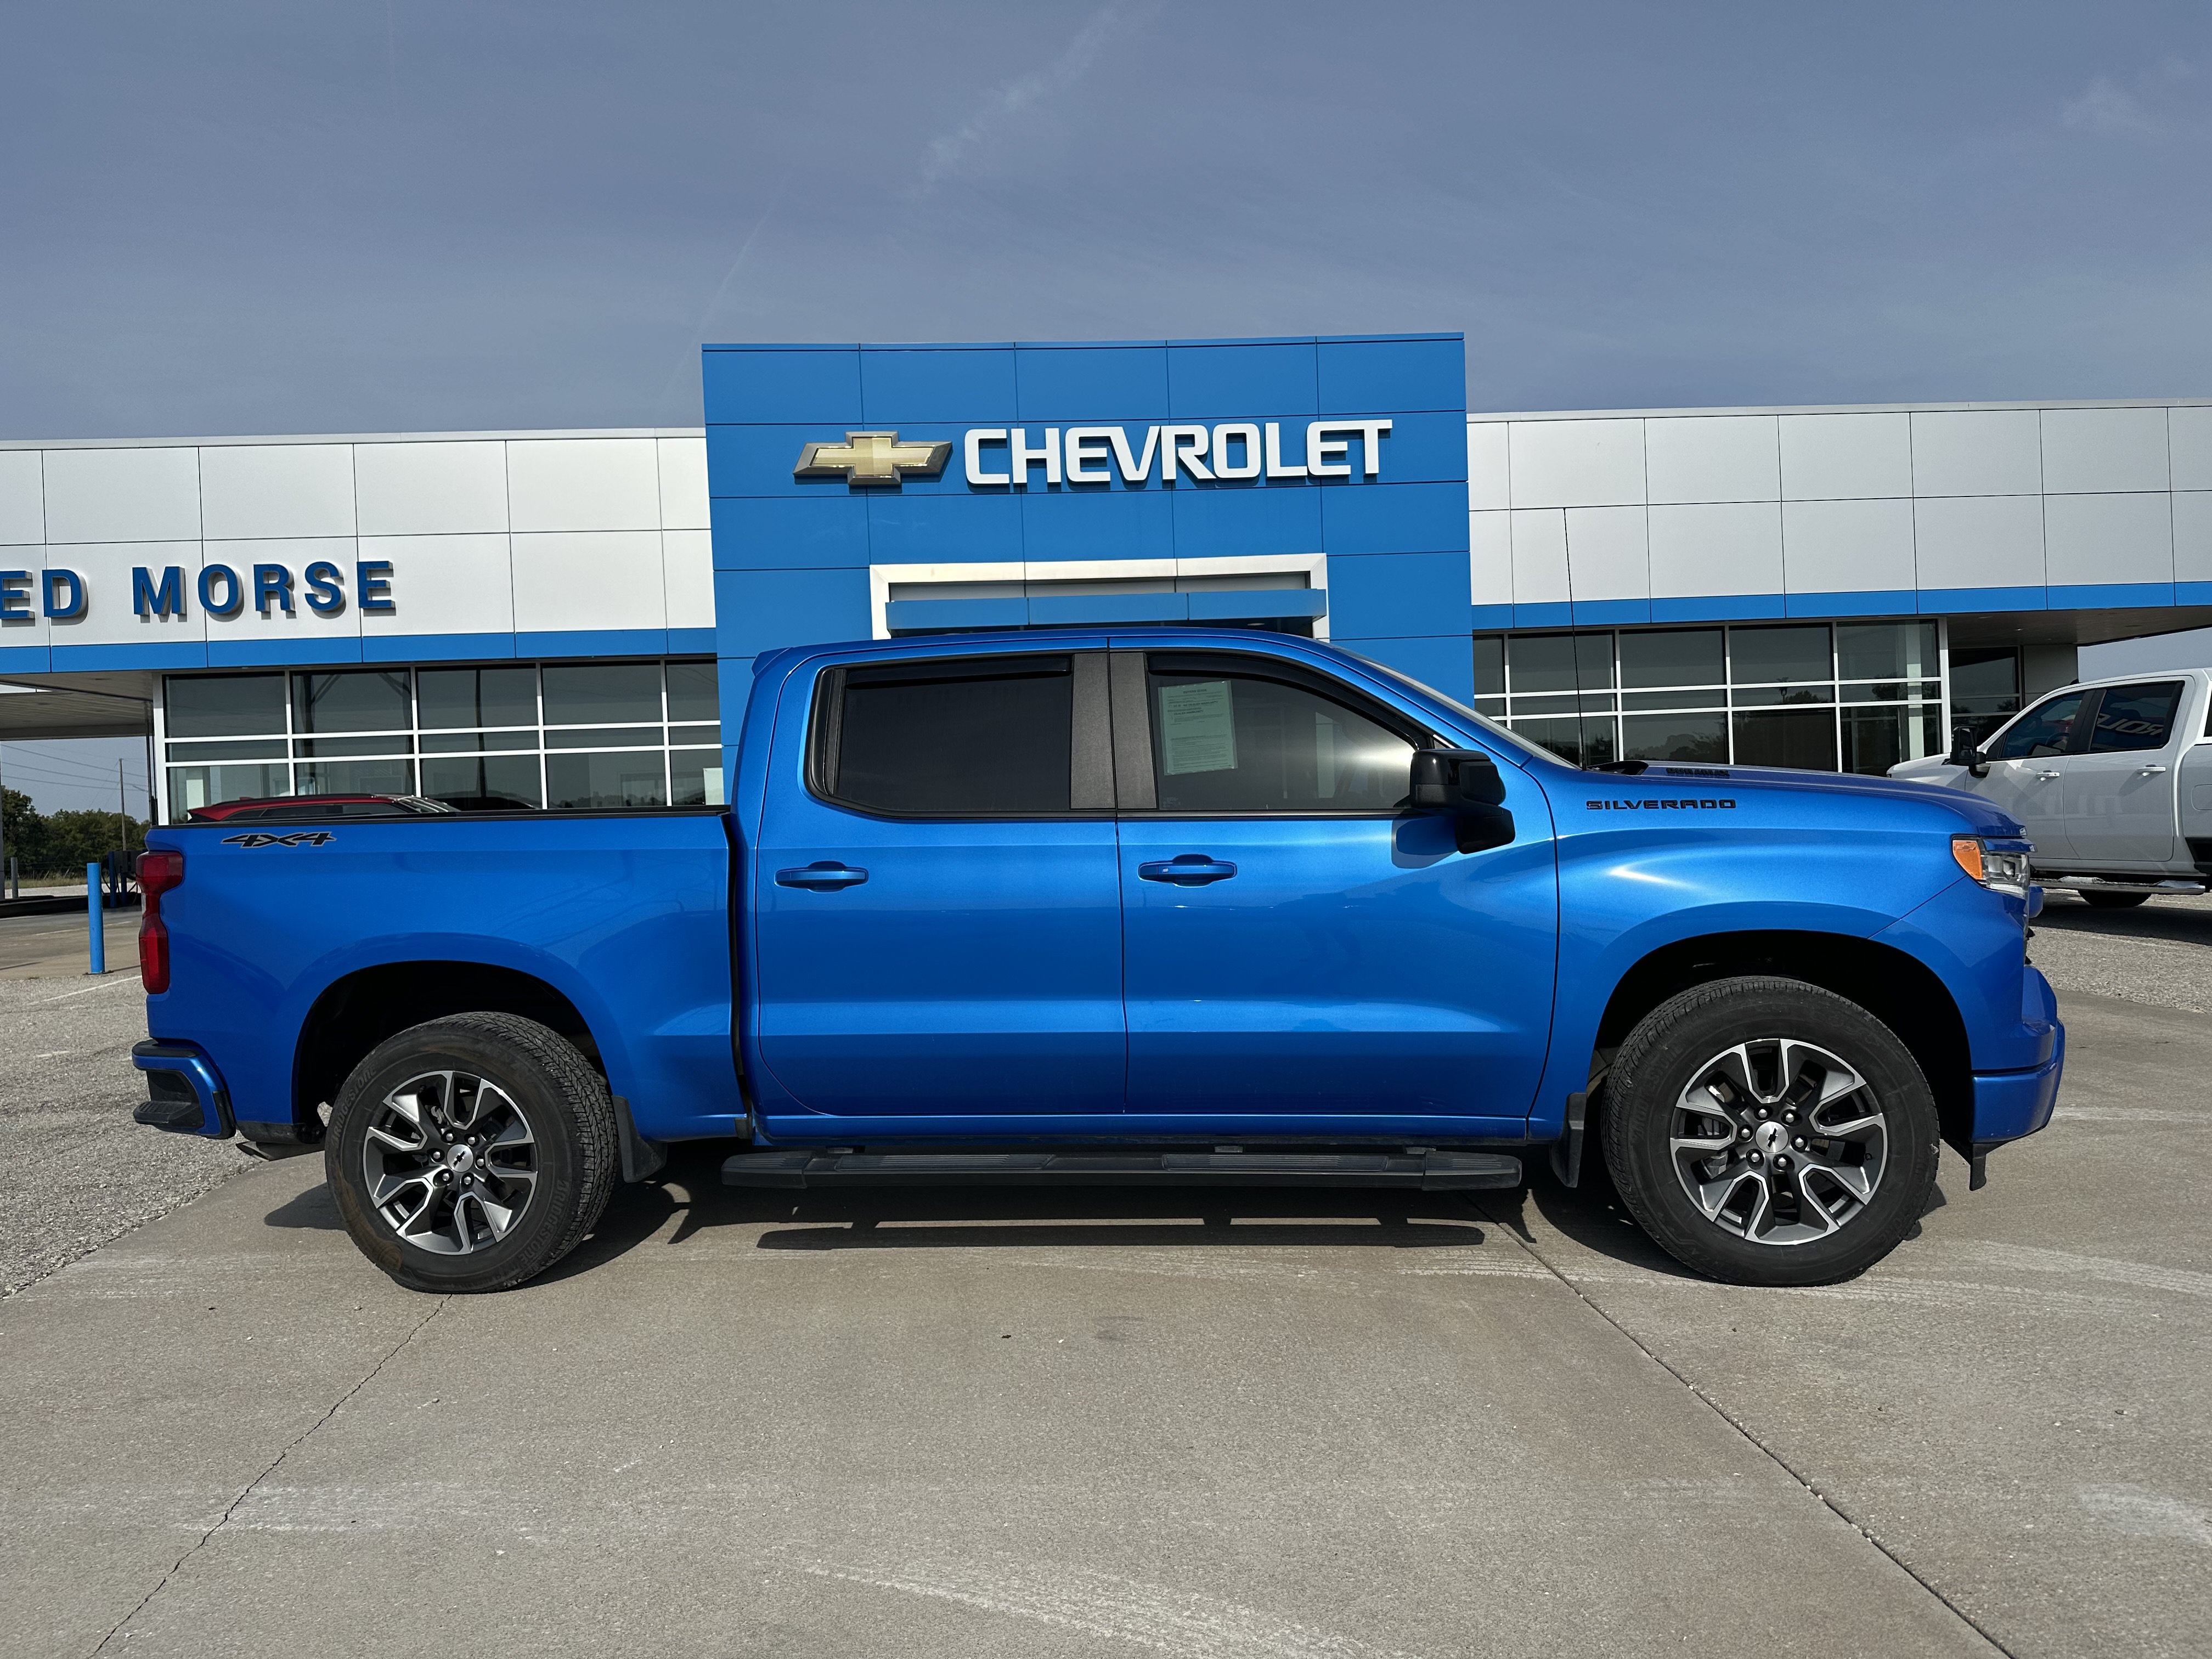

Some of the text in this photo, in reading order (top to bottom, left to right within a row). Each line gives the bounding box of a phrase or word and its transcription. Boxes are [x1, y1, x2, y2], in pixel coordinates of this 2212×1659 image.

[964, 419, 1392, 485] CHEVROLET
[0, 560, 396, 620] ED MORSE
[1586, 799, 1736, 810] SILVERADO
[331, 1065, 377, 1149] BRIDGESTONE
[518, 1179, 569, 1263] BRIDGESTONE
